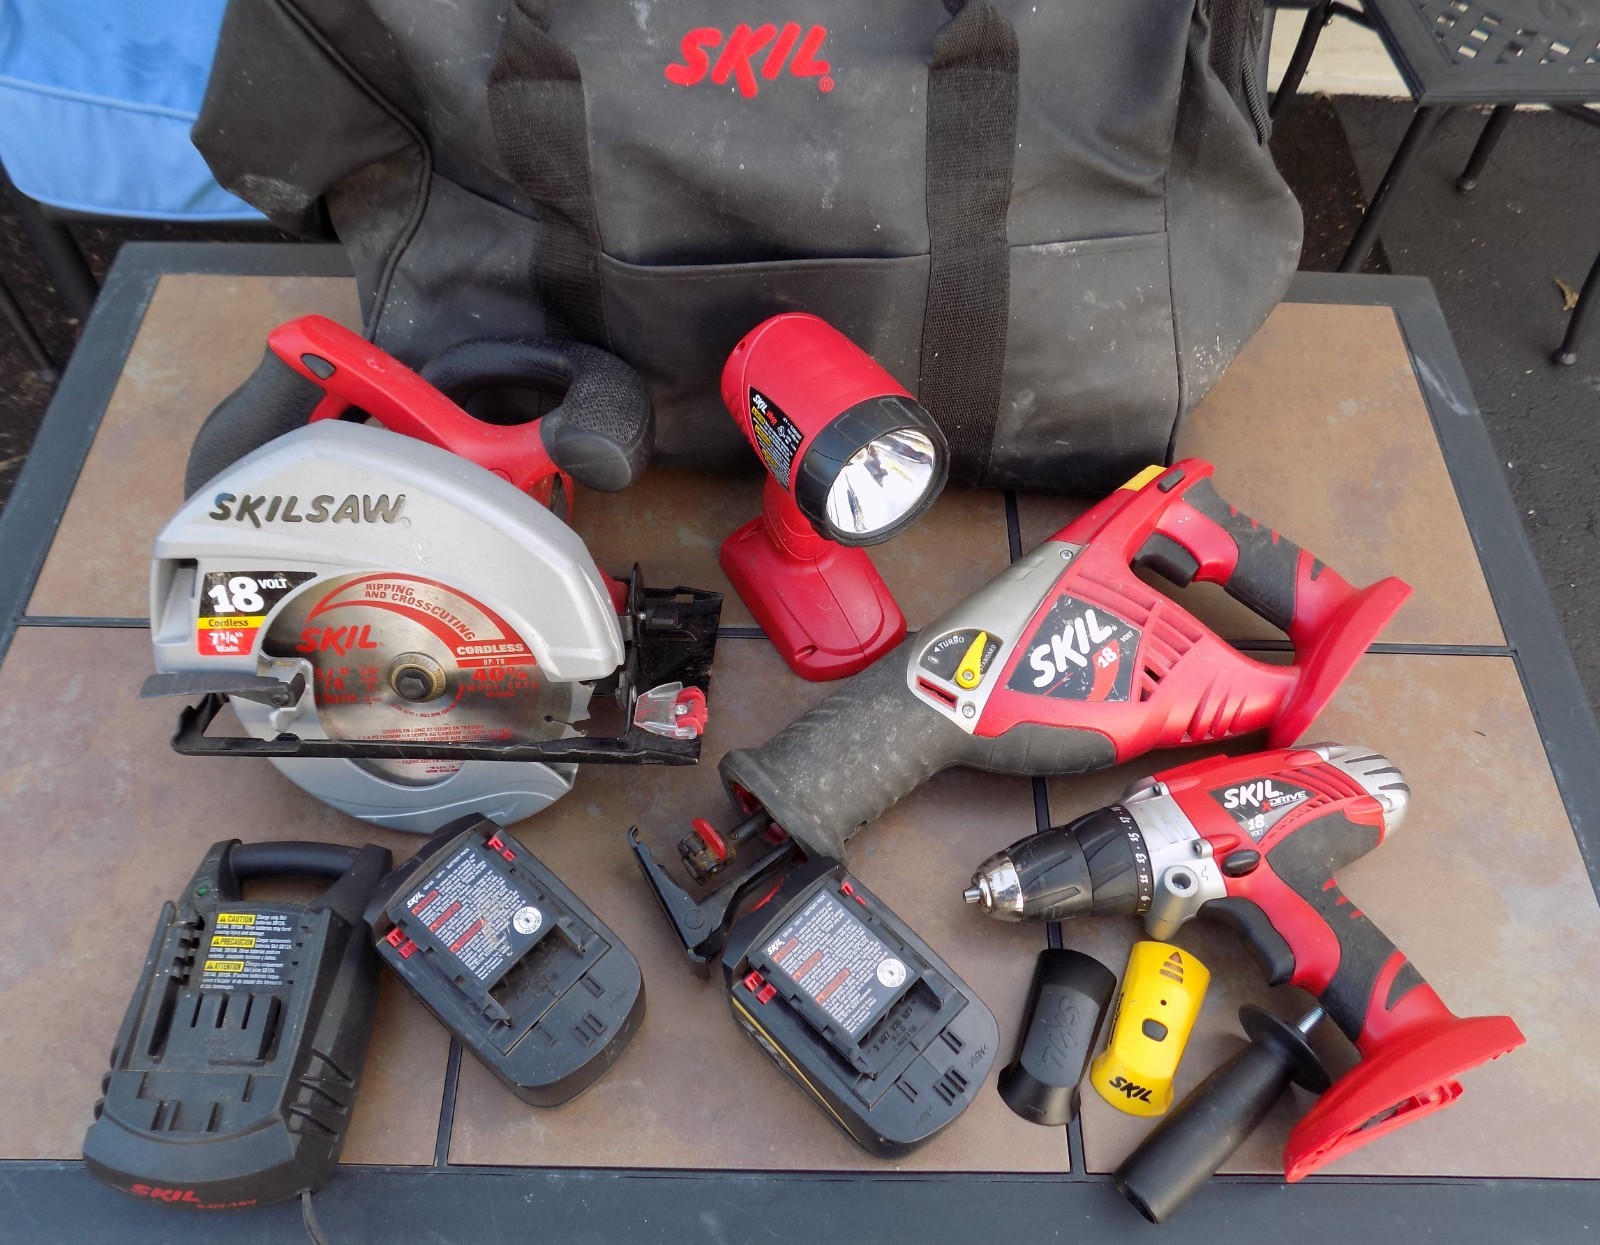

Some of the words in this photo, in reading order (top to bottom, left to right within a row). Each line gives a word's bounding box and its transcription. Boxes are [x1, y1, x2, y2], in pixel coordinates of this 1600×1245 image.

[664, 22, 831, 99] SKIL
[753, 395, 768, 414] SKIL
[209, 493, 406, 528] SKILSAW
[208, 576, 265, 613] 18
[258, 579, 288, 589] VOLT
[365, 591, 386, 599] AND
[366, 583, 414, 596] RIPPING
[209, 619, 249, 627] Cordless
[296, 625, 378, 656] SKIL
[938, 636, 965, 649] TURBO
[1120, 630, 1134, 643] VOLT
[216, 645, 239, 653] Blade
[457, 644, 524, 655] CORDLESS
[1030, 609, 1113, 688] SKIL
[1097, 647, 1118, 669] 18
[472, 667, 528, 682] 40%
[1224, 780, 1280, 809] SKIL
[1248, 814, 1265, 831] 18
[1128, 833, 1140, 842] 15
[1251, 829, 1263, 837] VOLT
[1136, 853, 1147, 864] 13
[407, 891, 425, 908] SKIL
[446, 855, 461, 869] BATTERY
[460, 847, 470, 857] PACK
[1140, 875, 1148, 883] 11
[767, 939, 784, 955] SKIL
[804, 902, 818, 917] BATTERY
[816, 894, 826, 904] PACK
[1109, 1076, 1151, 1103] SKIL
[130, 1184, 200, 1203] SKIL
